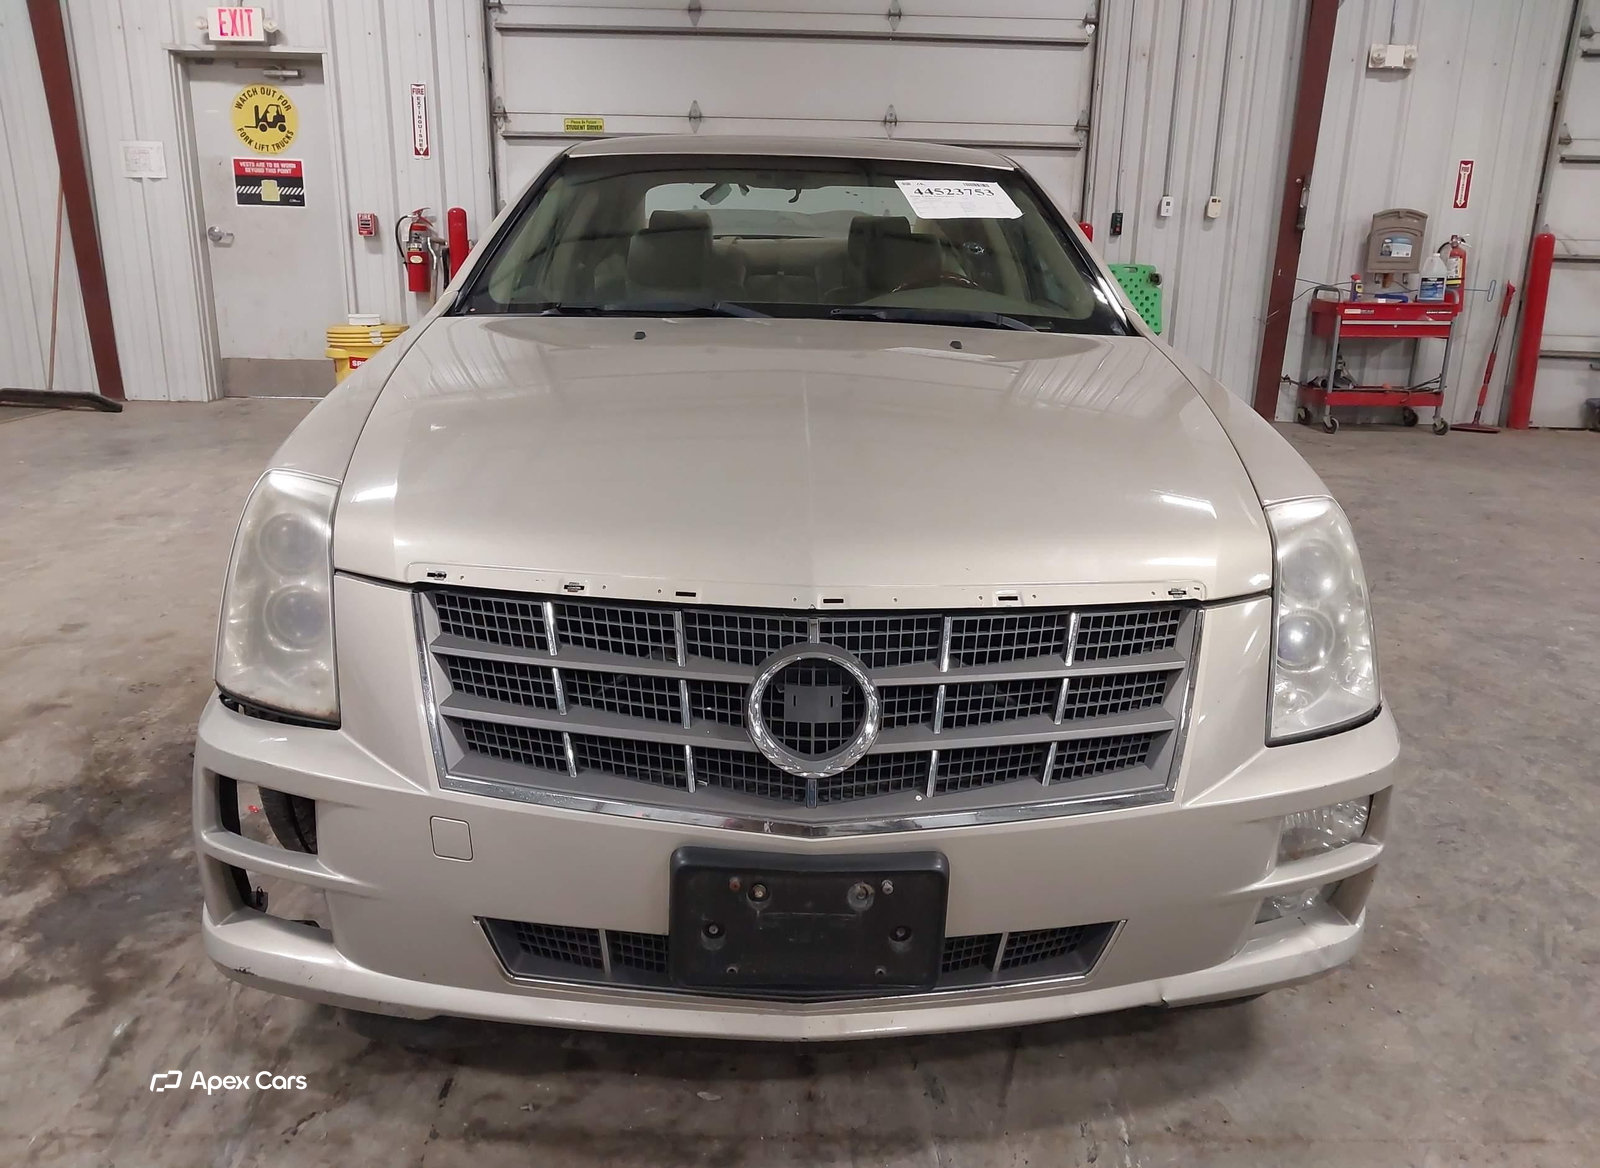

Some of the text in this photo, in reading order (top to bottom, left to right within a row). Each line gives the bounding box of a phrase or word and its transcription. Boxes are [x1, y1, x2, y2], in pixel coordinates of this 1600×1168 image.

[218, 9, 252, 36] EXIT
[234, 87, 292, 112] WATCH OUT FOR
[237, 128, 294, 152] FORK LIFT TRUCKS
[914, 188, 994, 196] 44523753
